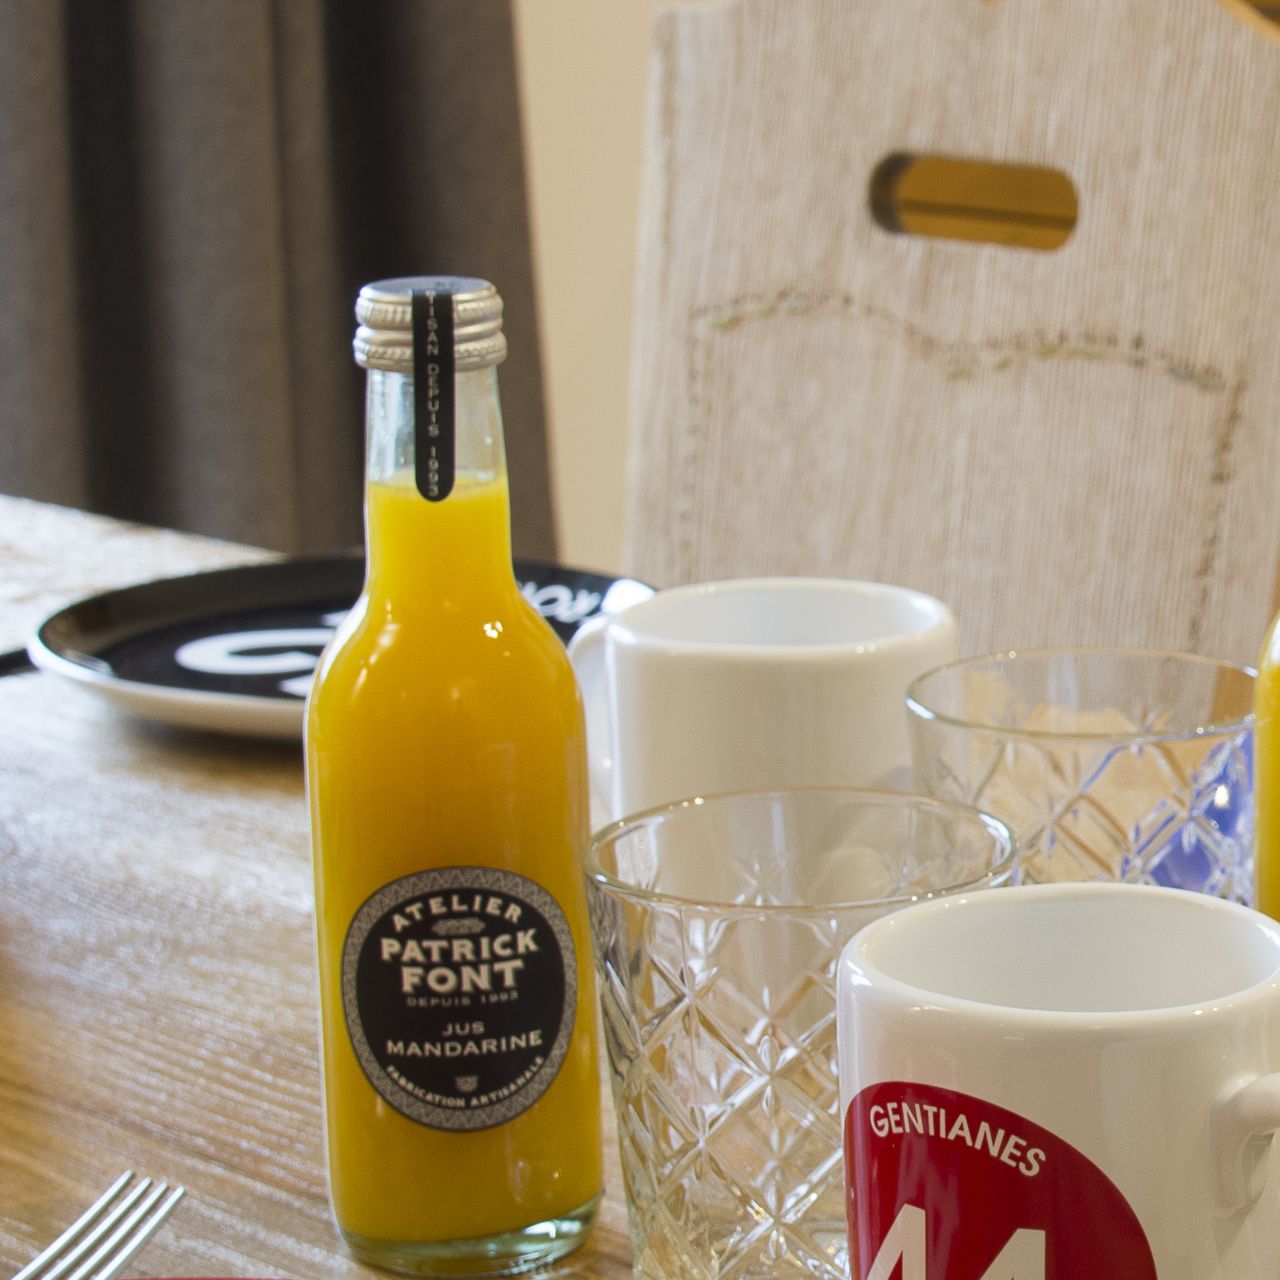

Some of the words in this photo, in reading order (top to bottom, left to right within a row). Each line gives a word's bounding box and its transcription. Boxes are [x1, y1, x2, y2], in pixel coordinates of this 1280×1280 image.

[392, 894, 523, 933] ATELIER
[379, 927, 541, 964] PATRICK
[400, 959, 525, 994] FONT
[406, 995, 472, 1009] DEPUIS
[385, 1029, 544, 1058] MANDARINE
[441, 1021, 486, 1037] JUS
[869, 1101, 1047, 1178] GENTIANES
